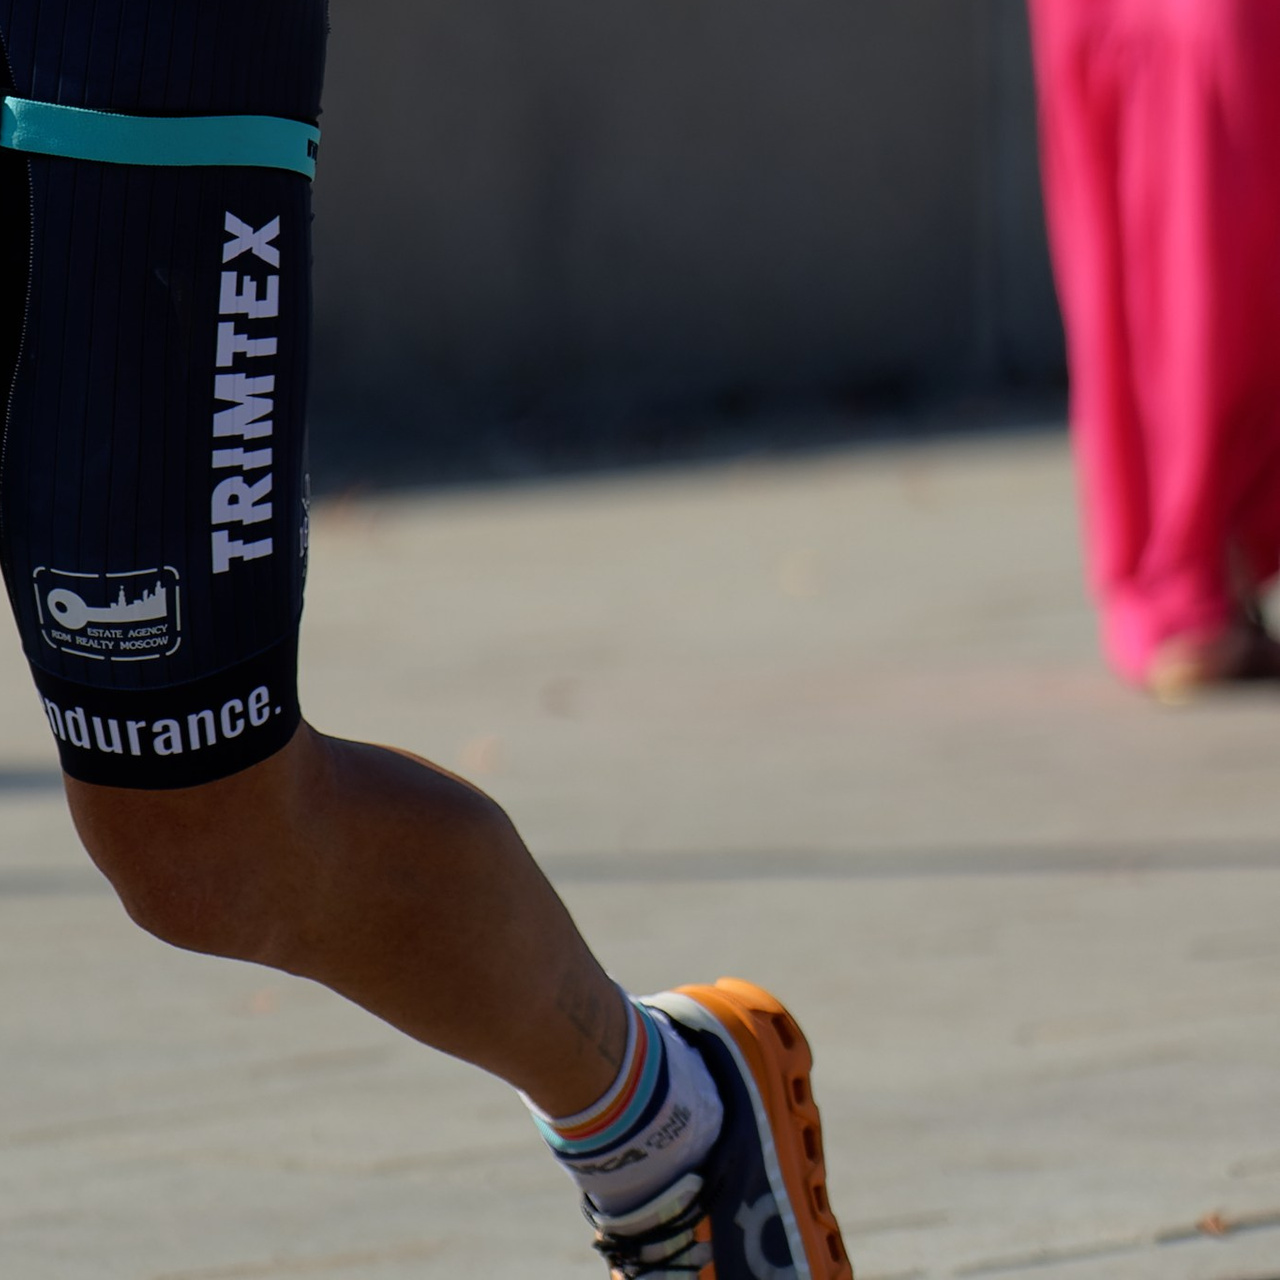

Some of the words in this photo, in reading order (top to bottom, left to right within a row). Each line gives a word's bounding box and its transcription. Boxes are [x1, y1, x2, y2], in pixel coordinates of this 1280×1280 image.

[211, 211, 280, 573] TRIMTEX
[75, 635, 114, 650] REALTY
[120, 635, 169, 650] MOSCOW
[87, 627, 122, 638] ESTATE
[128, 624, 168, 638] AGENCY
[42, 684, 282, 757] ndurance.
